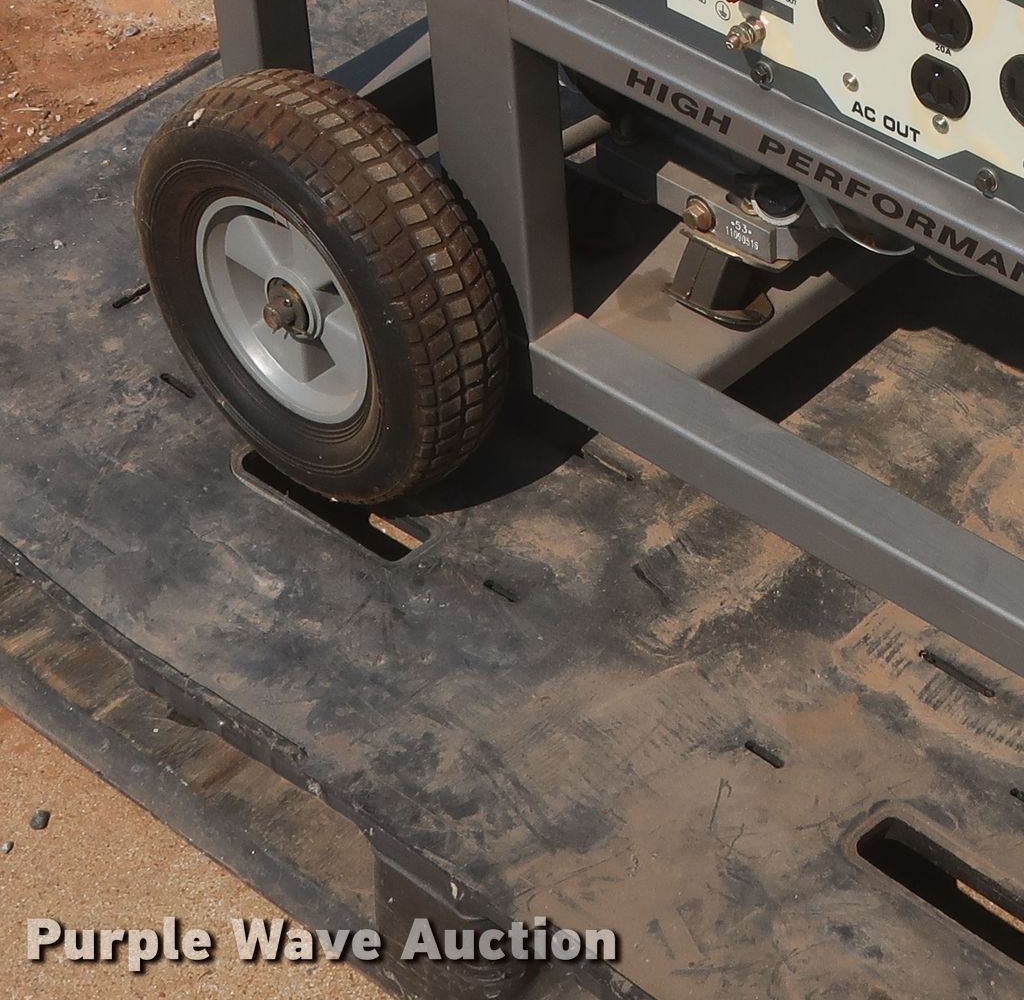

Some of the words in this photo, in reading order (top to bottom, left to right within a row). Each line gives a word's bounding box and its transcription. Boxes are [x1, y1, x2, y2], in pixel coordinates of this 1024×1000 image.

[934, 42, 952, 57] 20A
[625, 68, 732, 136] HIGH
[851, 100, 877, 124] AC
[883, 114, 921, 143] OUT
